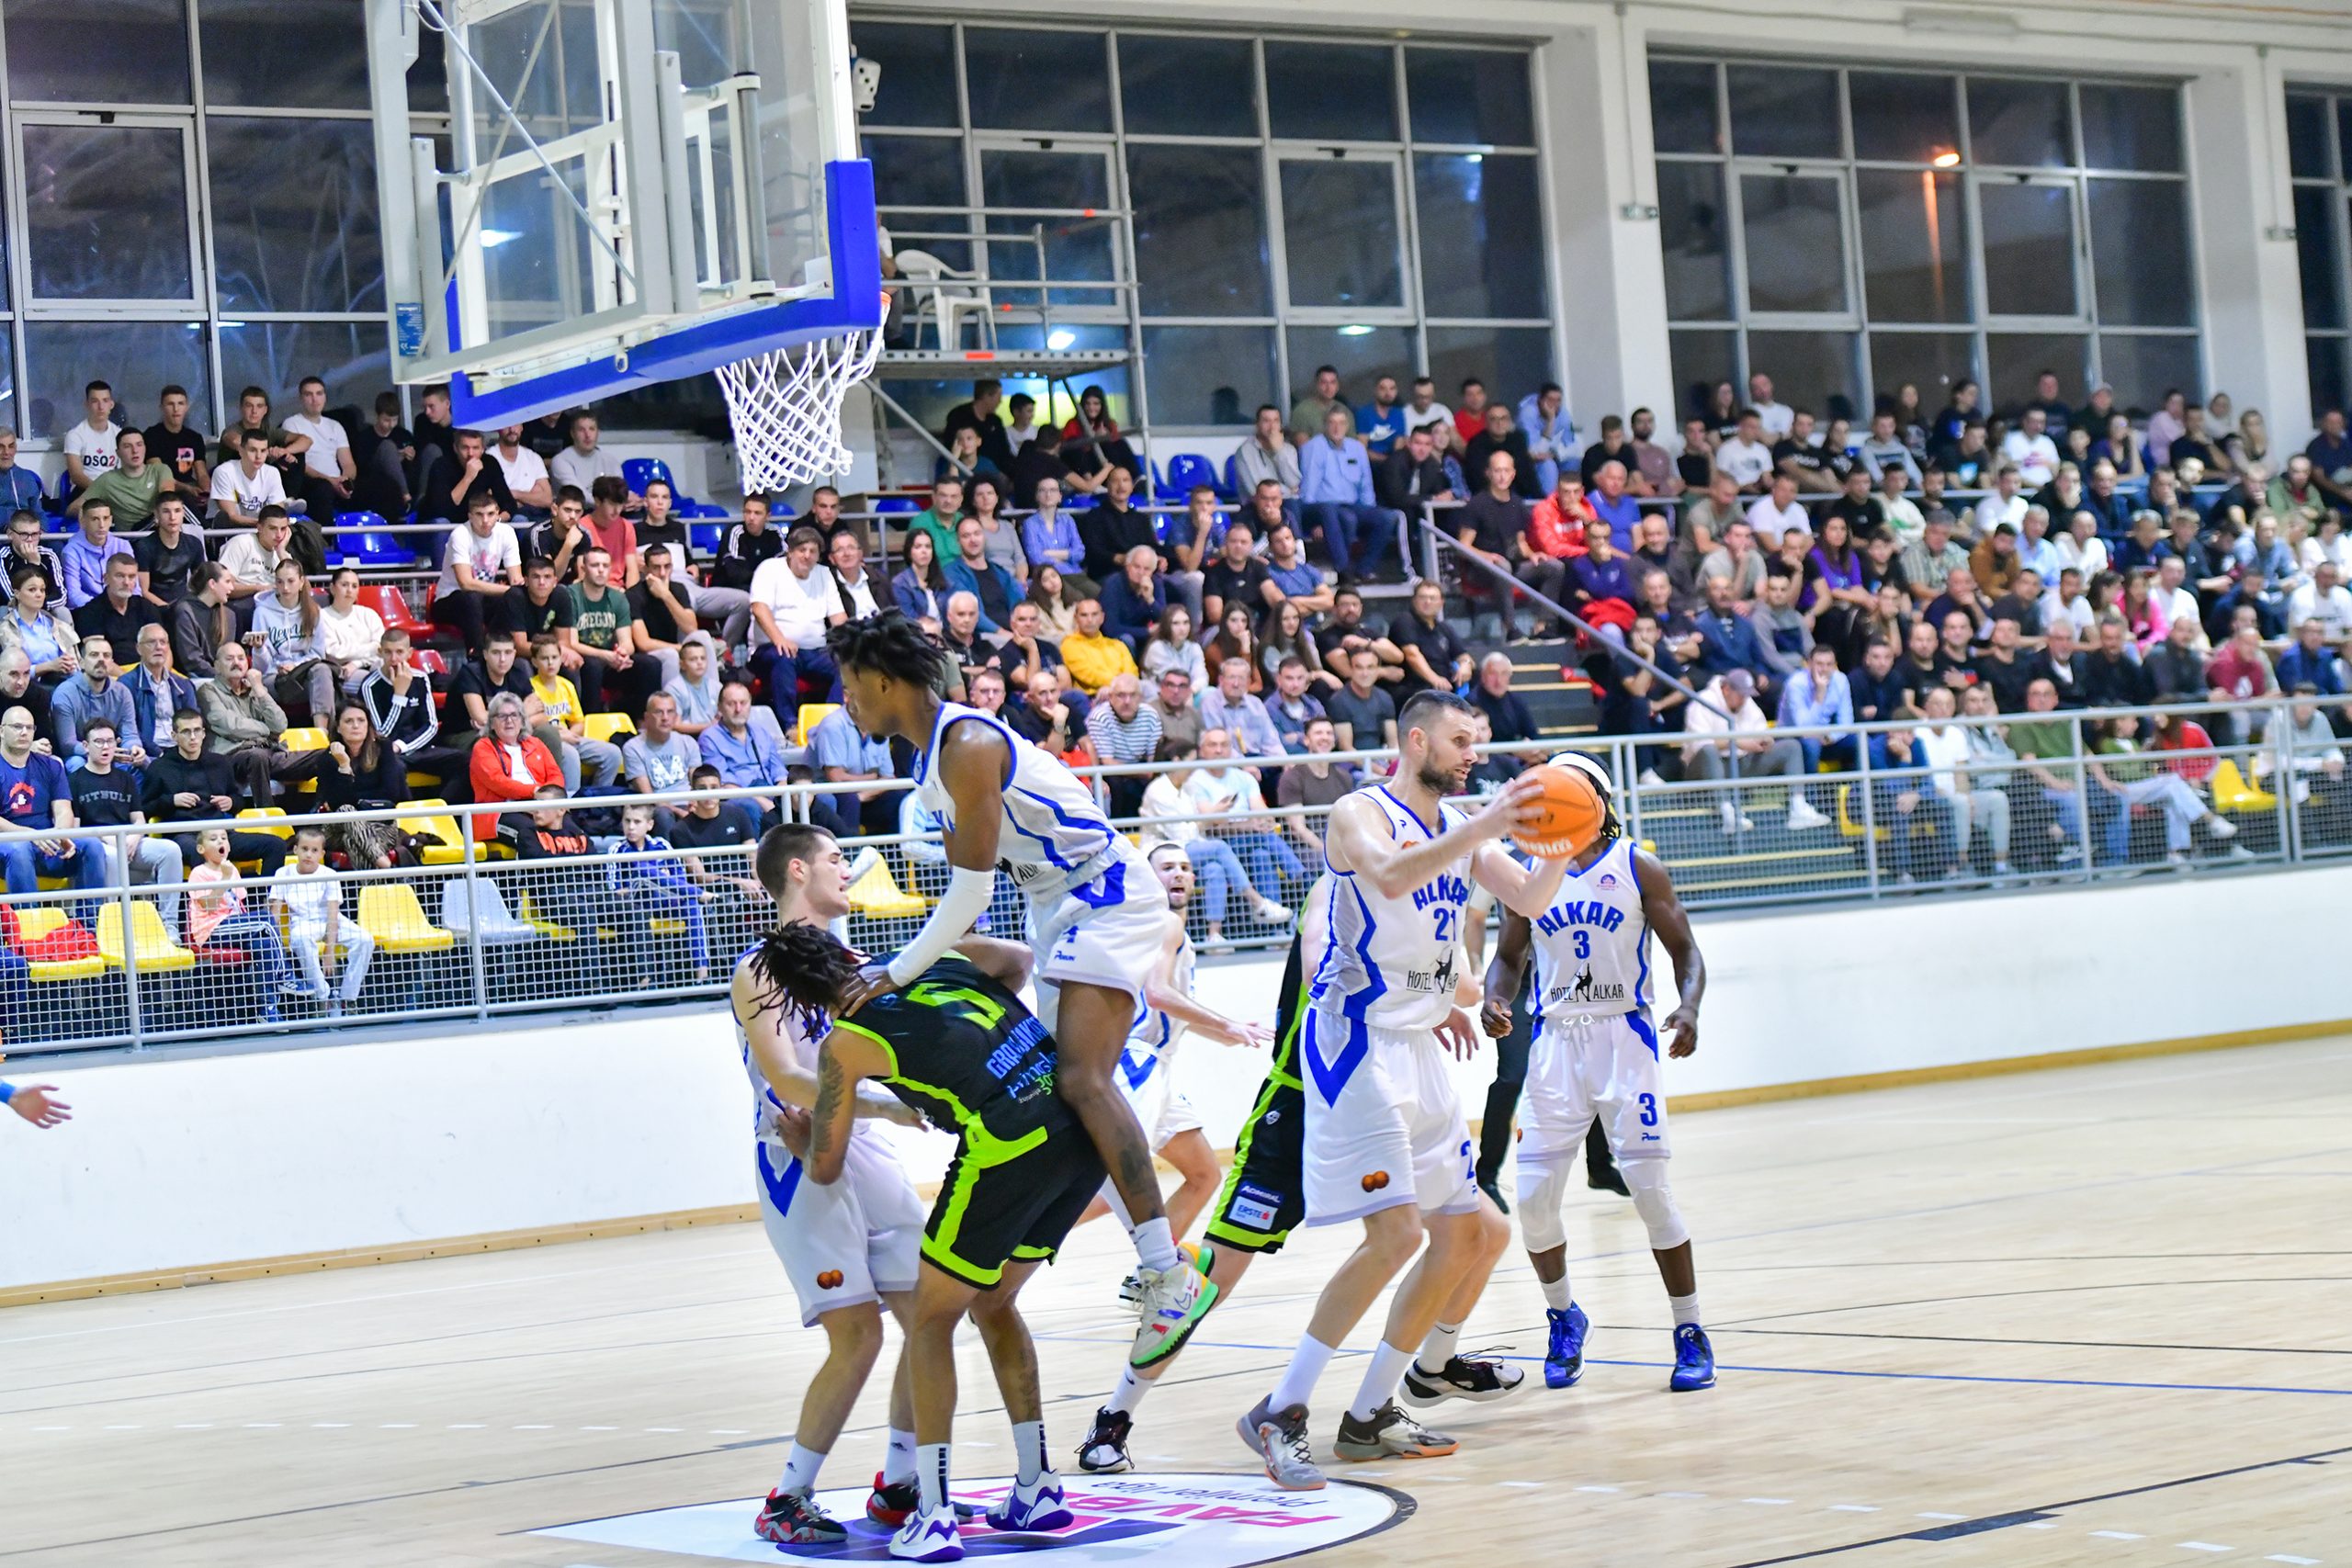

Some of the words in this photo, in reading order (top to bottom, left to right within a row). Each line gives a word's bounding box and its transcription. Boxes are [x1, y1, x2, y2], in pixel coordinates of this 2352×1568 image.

[83, 455, 116, 467] DSQ2
[577, 611, 616, 630] OREGON
[1536, 901, 1625, 938] ALKAR
[1572, 931, 1590, 959] 3
[1407, 970, 1432, 990] HOTEL
[1550, 987, 1574, 1002] HOTEL
[1593, 984, 1624, 999] ALKAR
[1639, 1093, 1657, 1126] 3
[1237, 1205, 1263, 1219] ERSTE
[1091, 1481, 1159, 1495] liga
[950, 1485, 1341, 1528] FAVBT
